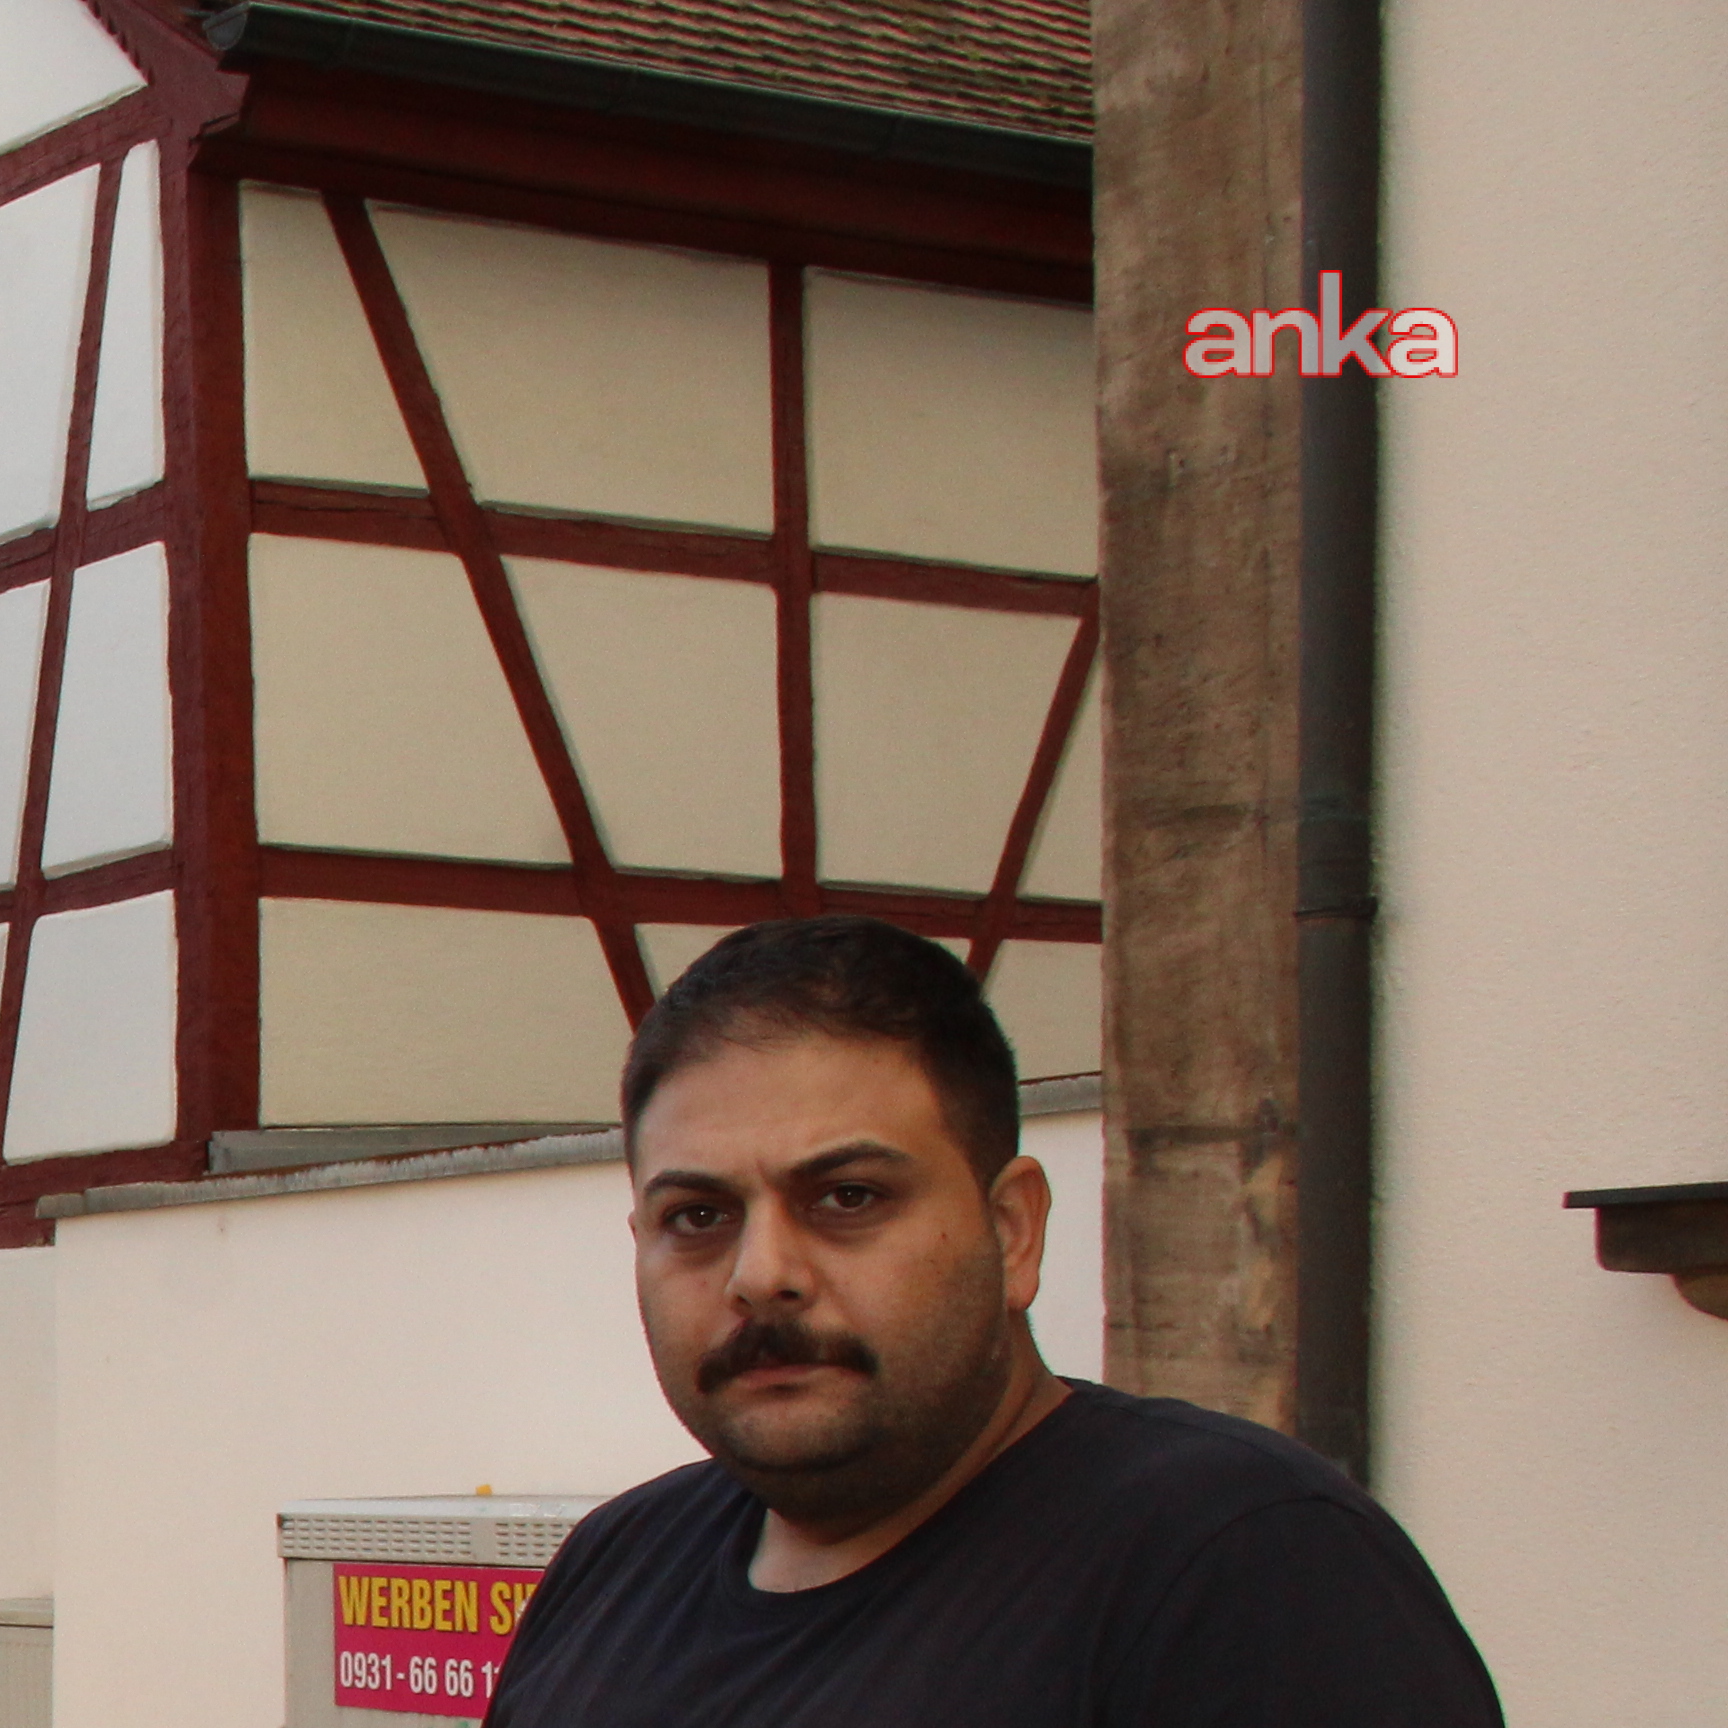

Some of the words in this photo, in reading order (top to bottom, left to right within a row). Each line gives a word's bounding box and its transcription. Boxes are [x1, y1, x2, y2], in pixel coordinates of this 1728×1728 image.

[338, 1576, 479, 1633] WERBEN
[445, 1659, 474, 1698] 66
[481, 1660, 501, 1698] 1
